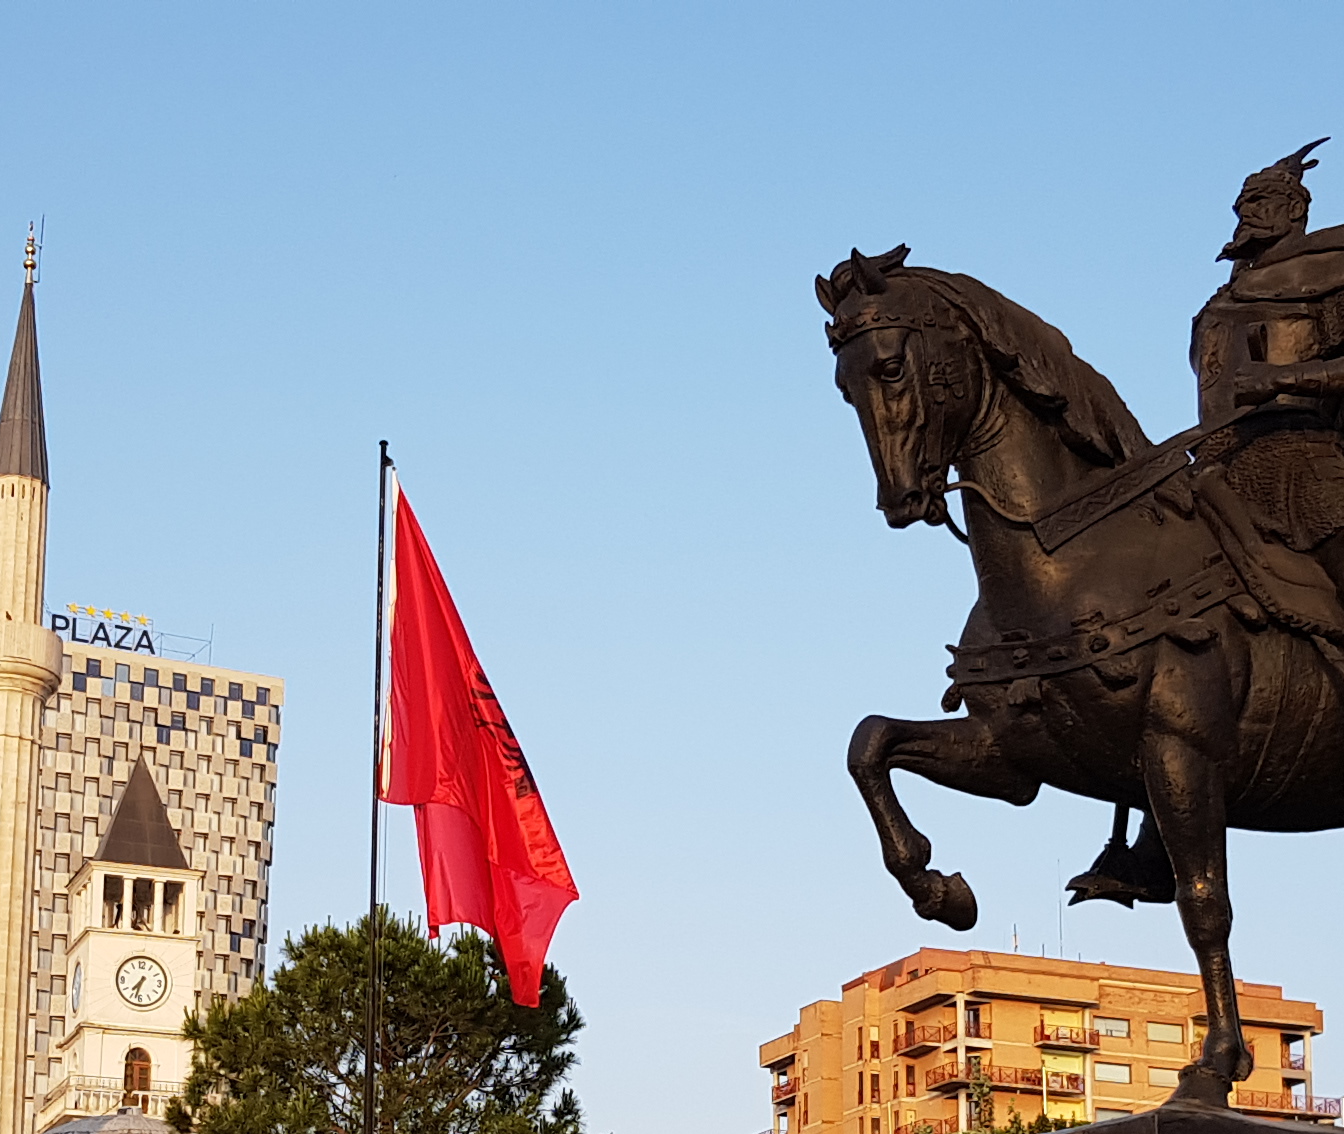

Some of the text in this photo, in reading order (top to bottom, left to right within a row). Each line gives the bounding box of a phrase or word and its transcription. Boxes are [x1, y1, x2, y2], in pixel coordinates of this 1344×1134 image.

[51, 613, 156, 655] PLAZA
[138, 960, 146, 970] 12
[120, 975, 126, 984] 9
[157, 979, 163, 988] 3
[137, 994, 143, 1003] 6
